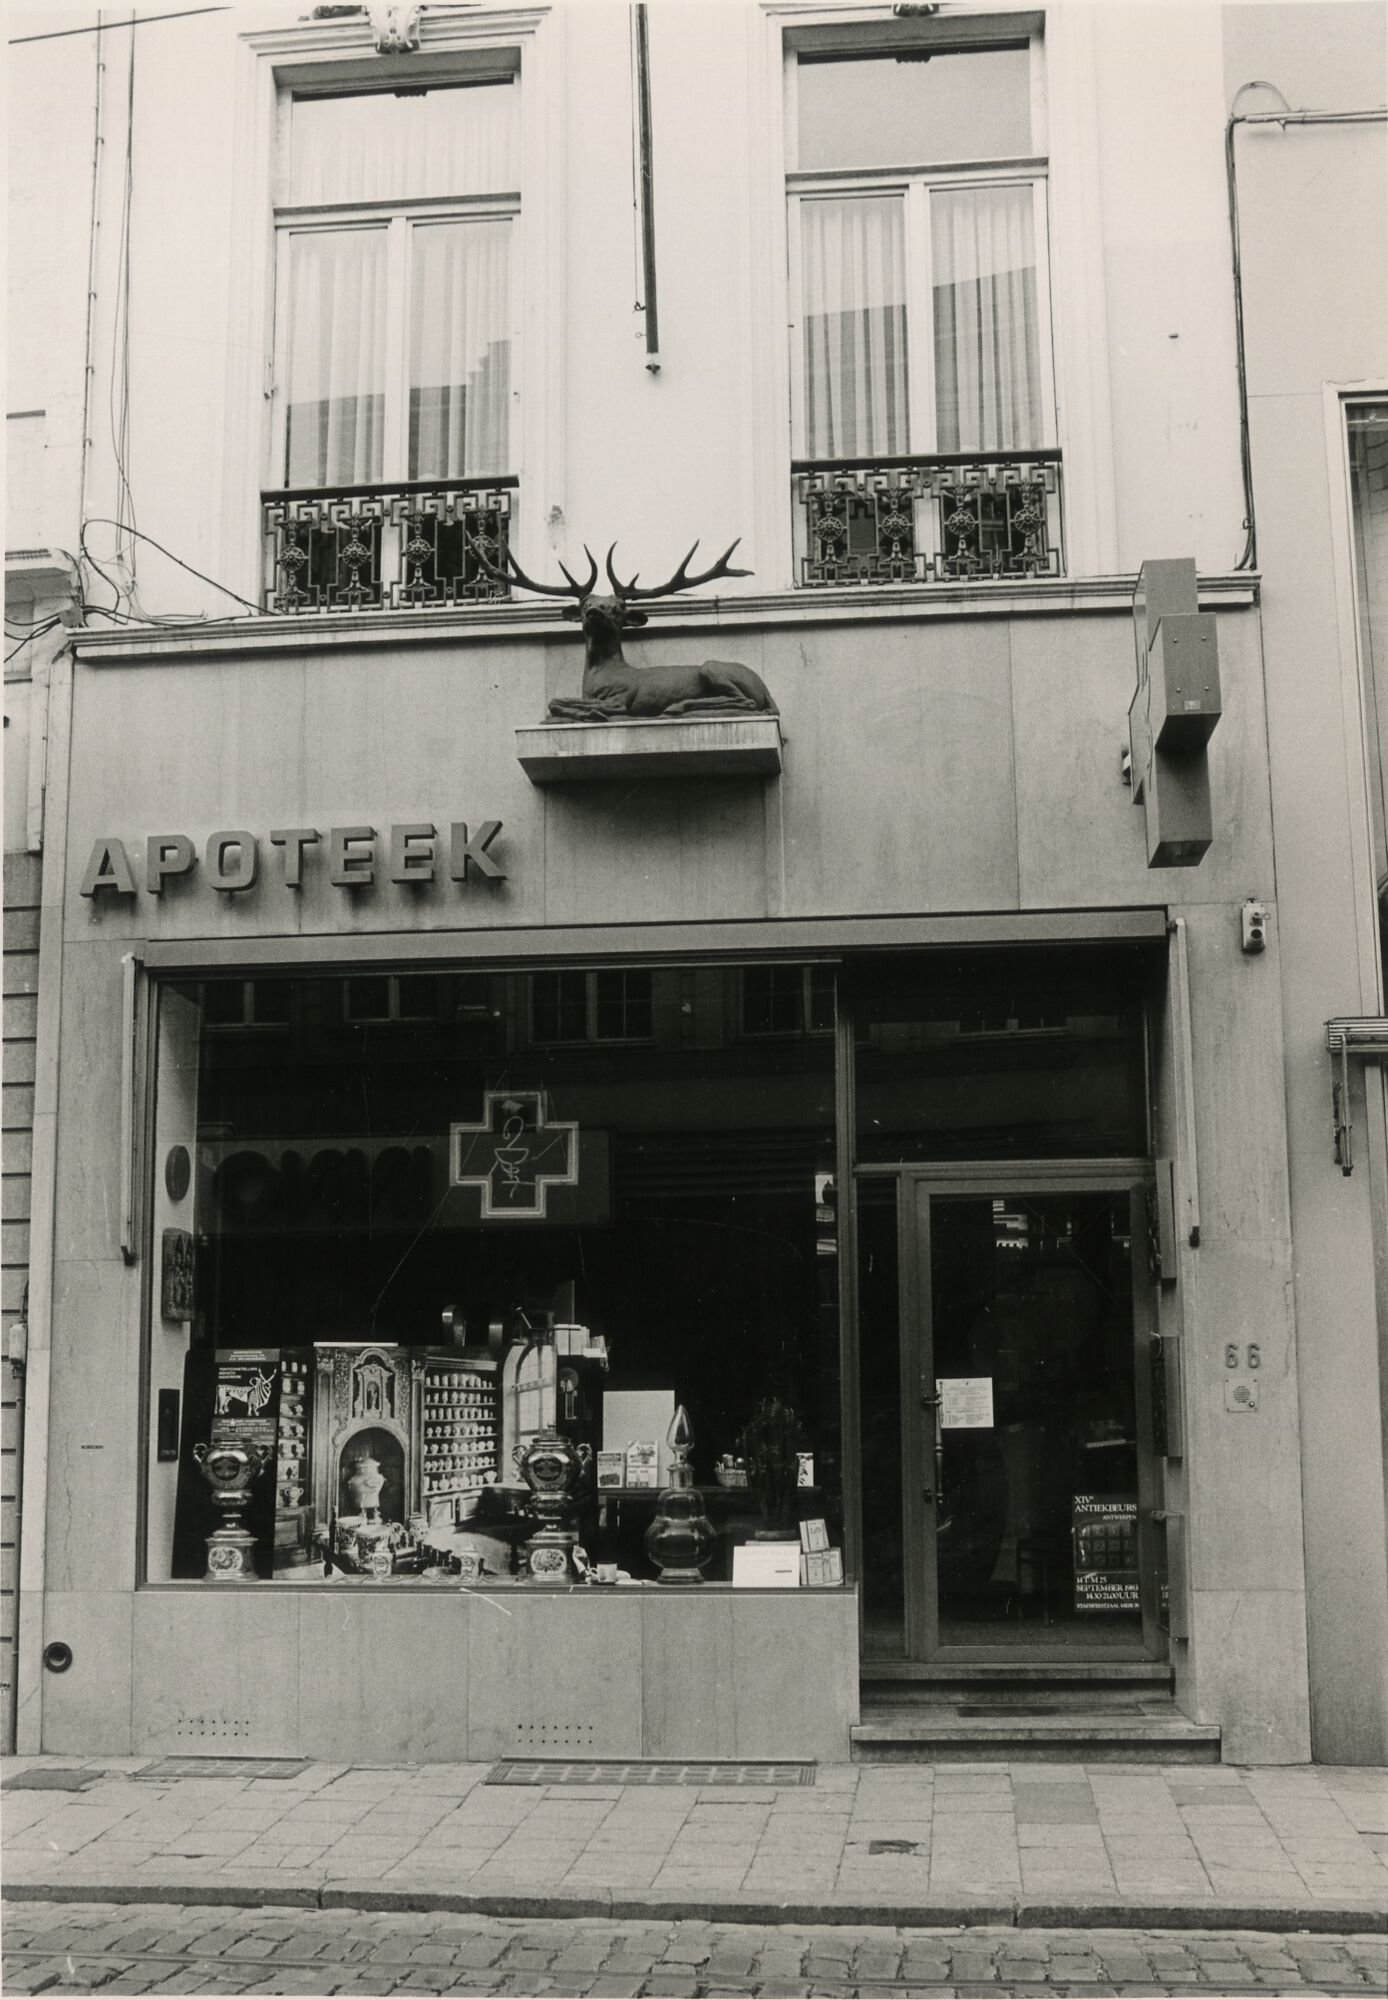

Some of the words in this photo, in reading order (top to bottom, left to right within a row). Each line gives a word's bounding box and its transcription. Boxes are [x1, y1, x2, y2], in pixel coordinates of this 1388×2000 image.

[80, 820, 507, 898] APOTEEK
[1224, 1343, 1262, 1369] 66
[1075, 1504, 1137, 1512] ANTIEKBEURS
